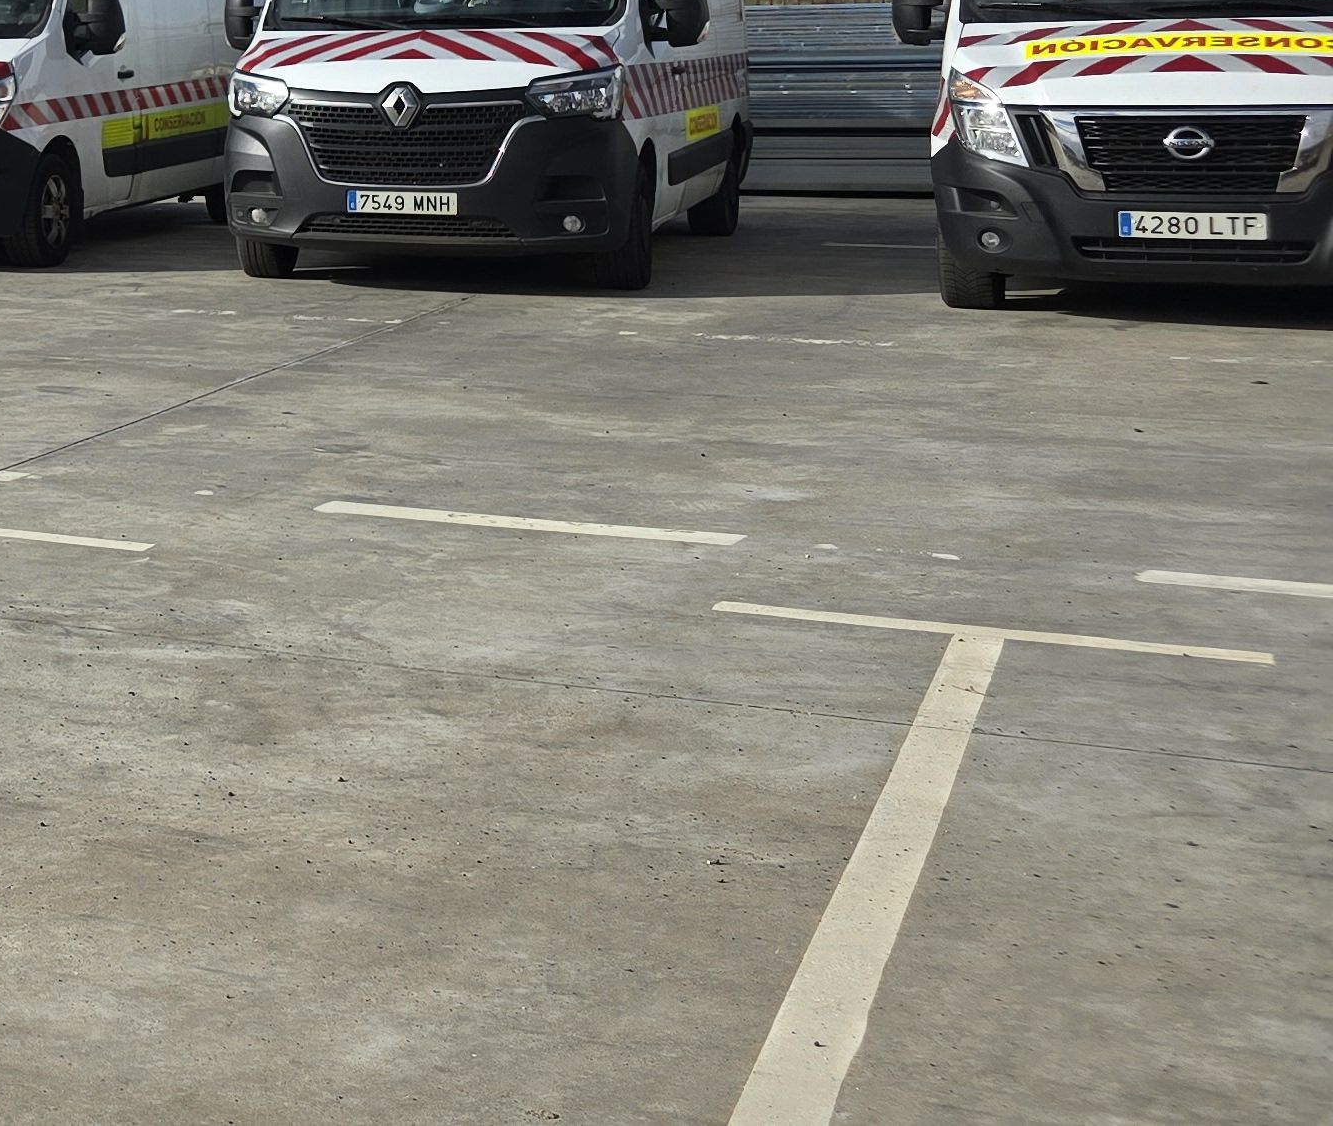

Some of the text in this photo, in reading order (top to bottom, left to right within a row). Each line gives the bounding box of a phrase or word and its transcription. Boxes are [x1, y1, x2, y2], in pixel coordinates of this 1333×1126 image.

[360, 194, 450, 212] 7549 MNH
[1134, 215, 1258, 236] 4280 LTF
